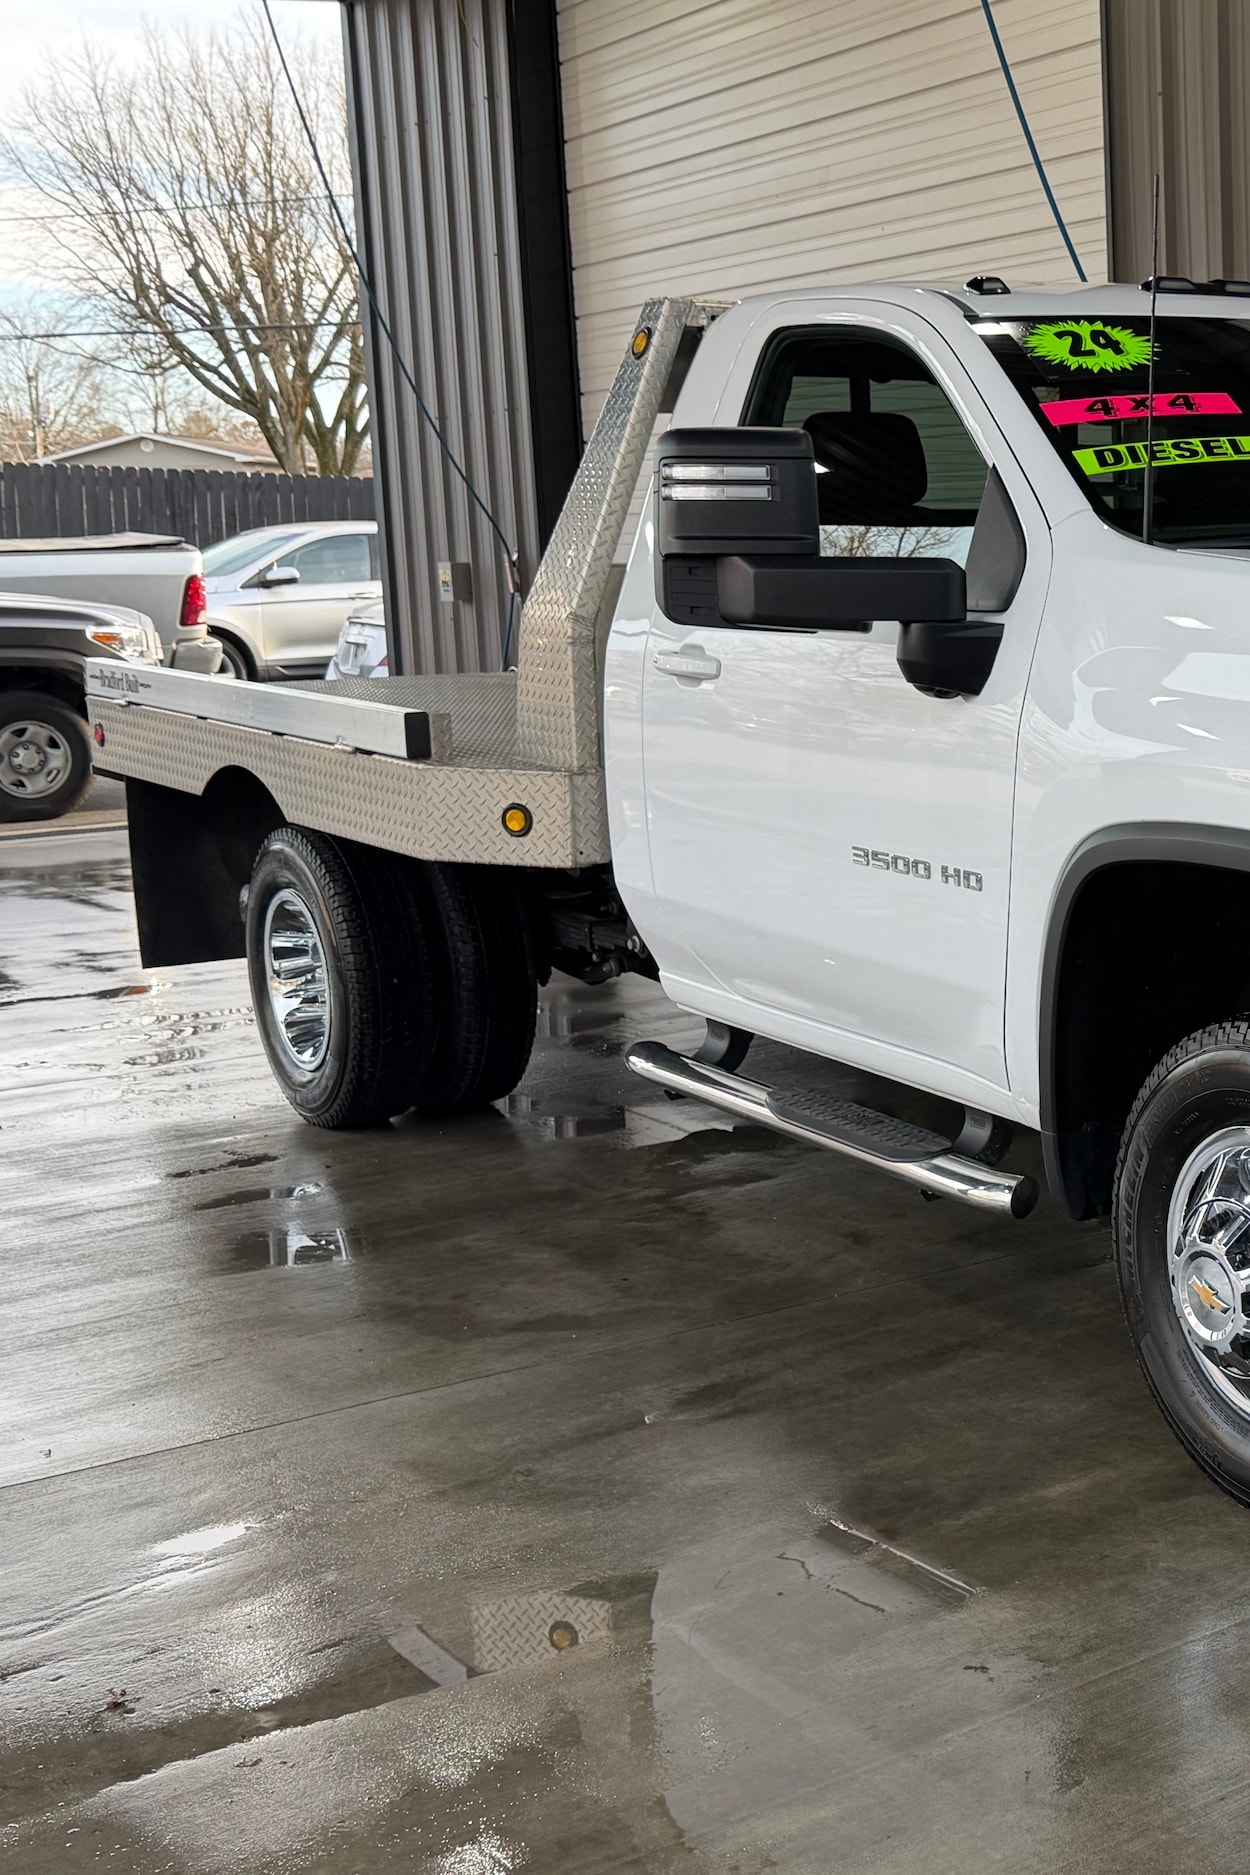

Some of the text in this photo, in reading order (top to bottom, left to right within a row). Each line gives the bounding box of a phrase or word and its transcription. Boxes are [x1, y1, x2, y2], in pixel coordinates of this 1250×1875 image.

[1053, 329, 1125, 358] 24
[851, 845, 983, 892] 3500 HD
